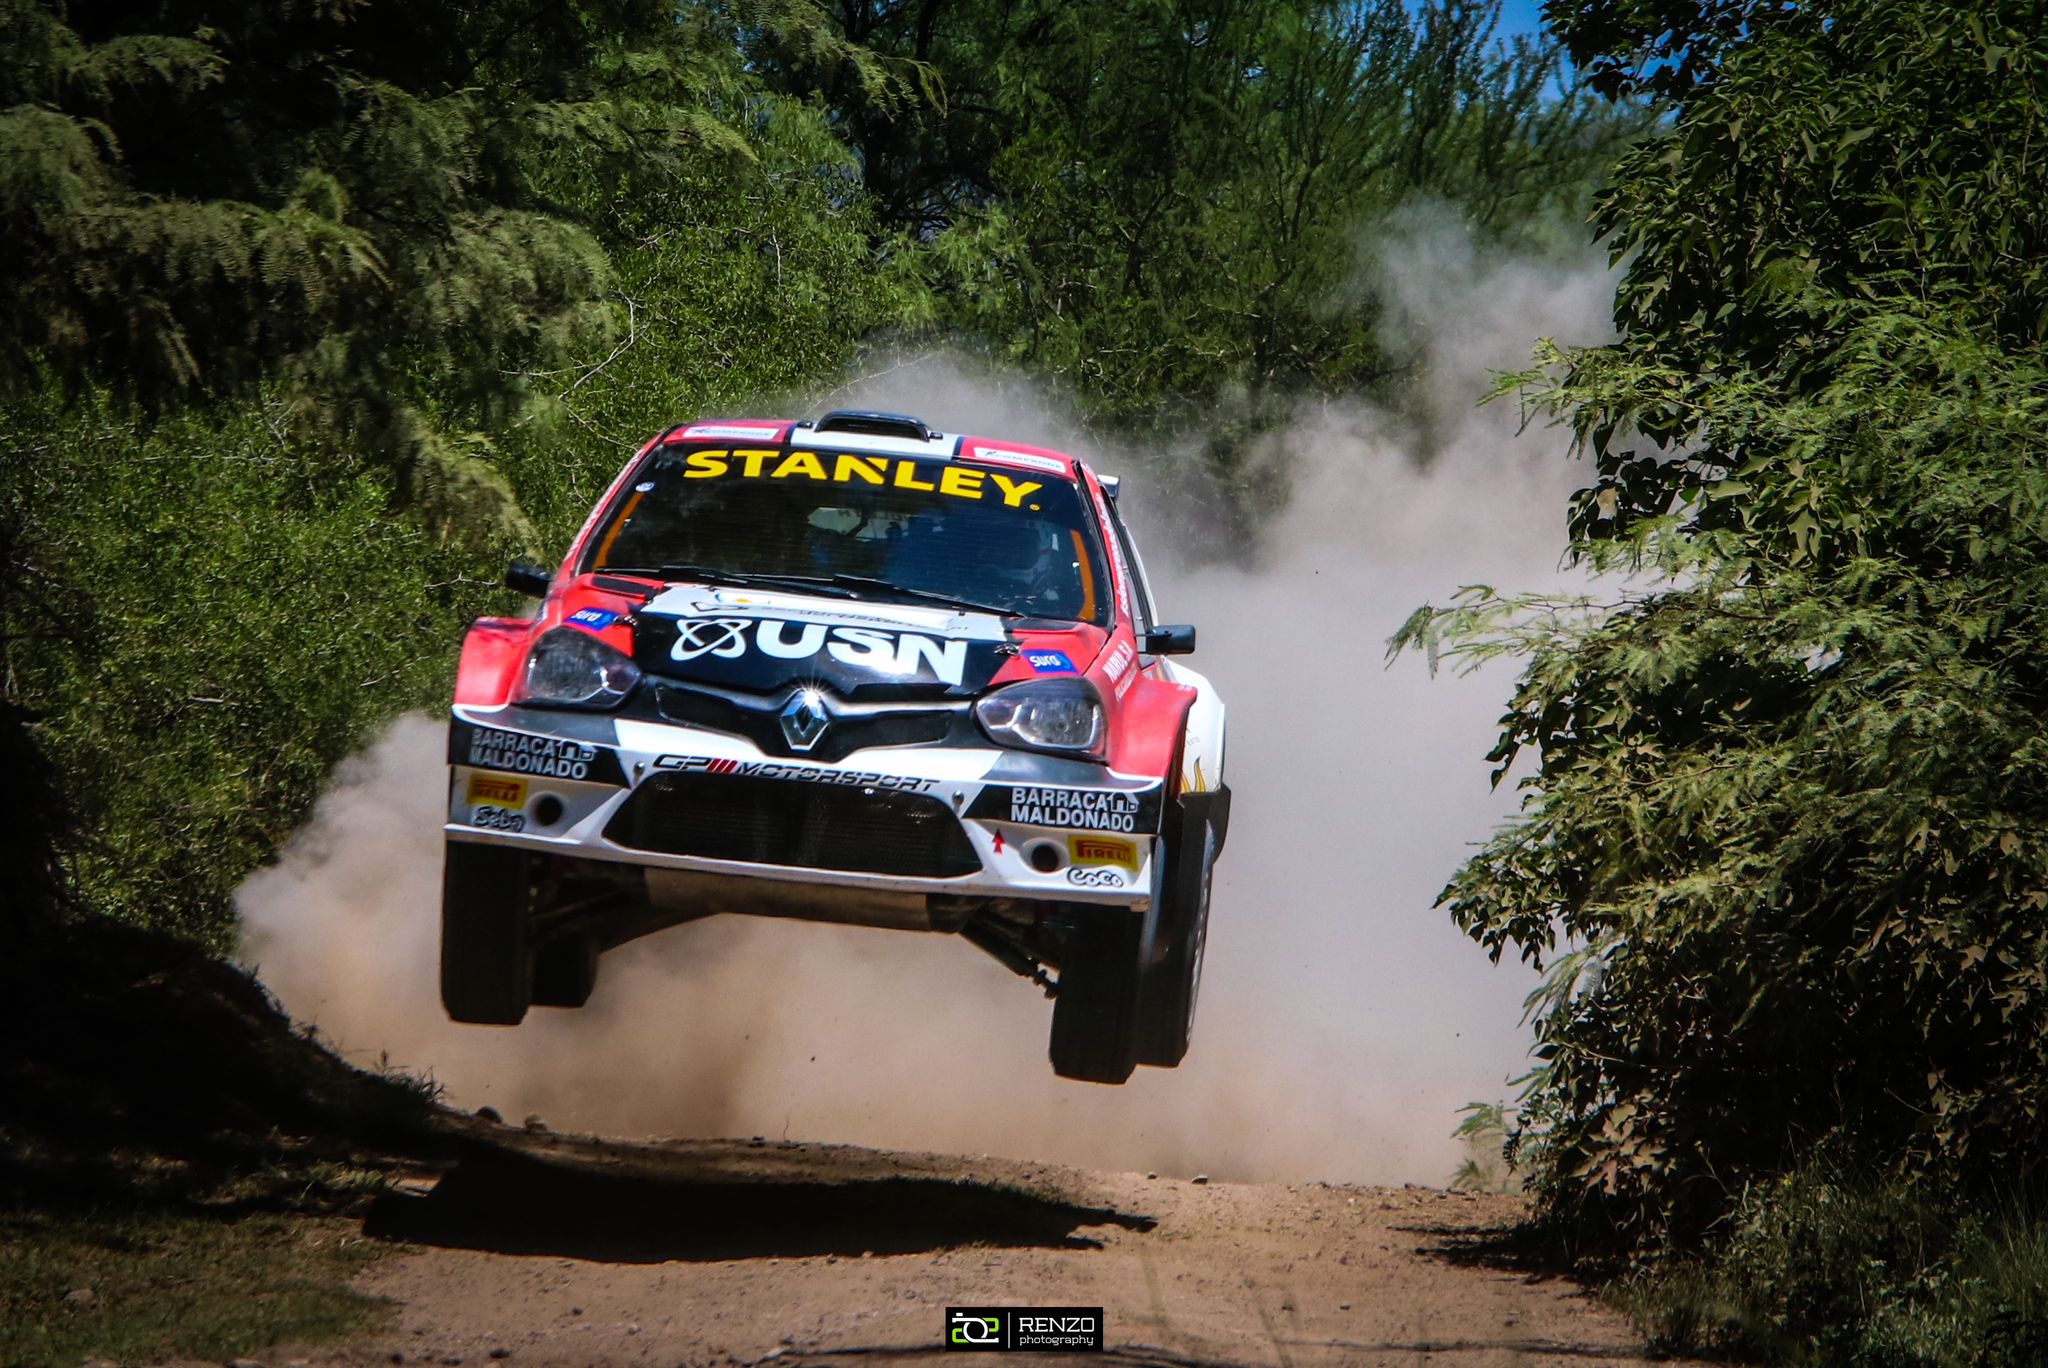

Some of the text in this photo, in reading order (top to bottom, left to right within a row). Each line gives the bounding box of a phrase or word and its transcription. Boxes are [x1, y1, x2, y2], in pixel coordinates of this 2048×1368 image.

[683, 450, 1042, 509] STANLEY
[756, 620, 968, 686] USN
[471, 729, 556, 757] BARRACA
[469, 747, 587, 779] MALDONADO
[737, 762, 940, 792] MOTORSPORT
[1012, 788, 1108, 811] BARRACA
[1011, 805, 1133, 832] MALDONADO
